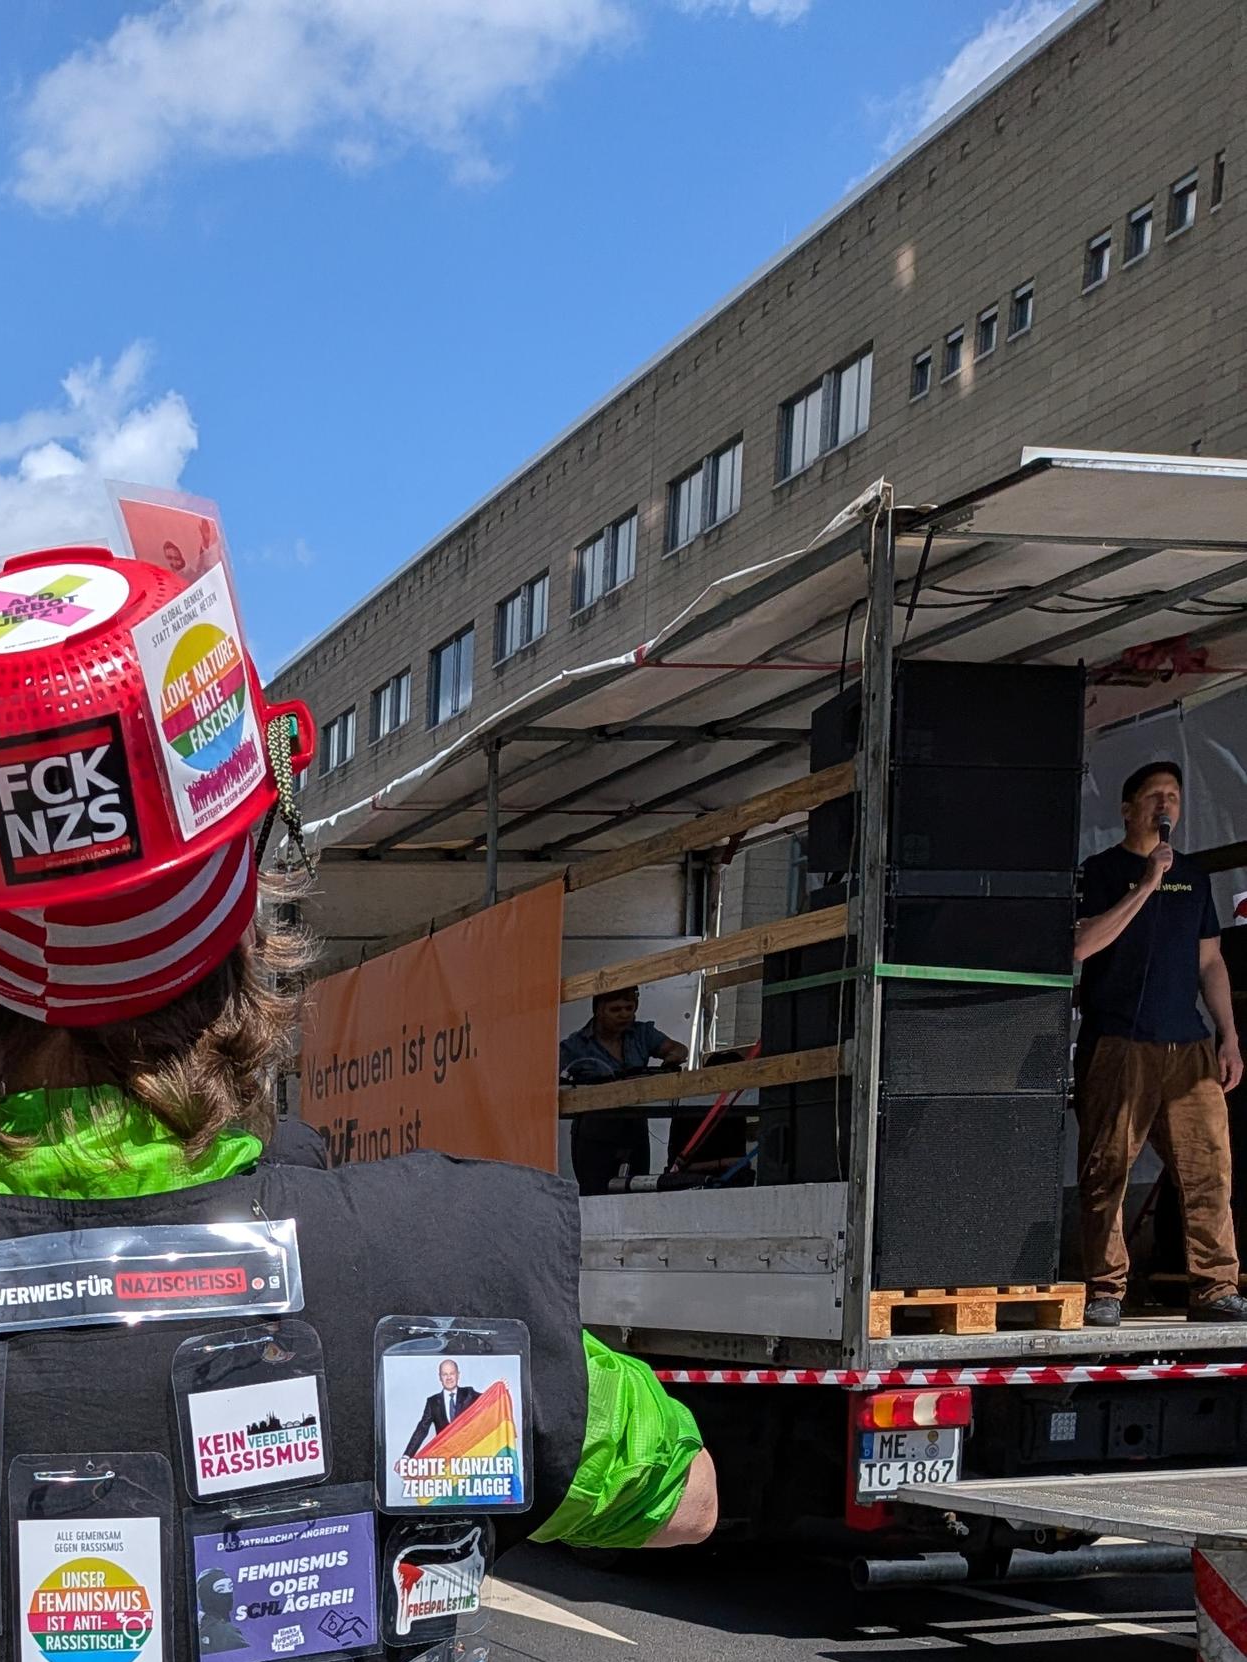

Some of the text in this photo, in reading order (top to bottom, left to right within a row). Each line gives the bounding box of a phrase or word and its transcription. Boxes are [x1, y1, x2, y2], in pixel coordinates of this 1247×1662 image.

[161, 635, 236, 713] LOVE NATURE
[192, 684, 224, 721] HATE
[189, 695, 239, 753] FASCISM
[4, 793, 127, 858] NZS
[307, 1011, 477, 1100] Vertrauen ist gut.
[399, 1106, 421, 1155] ist
[76, 1275, 113, 1297] FÜR
[121, 1272, 242, 1294] NAZISCHEISS!
[199, 1425, 318, 1457] KEIN VEEDEL FÜR
[880, 1434, 906, 1459] ME
[201, 1440, 320, 1479] RASSISMUS
[399, 1456, 514, 1477] ECHTE KANZLER
[865, 1460, 954, 1487] TC 1867
[402, 1477, 511, 1497] ZEIGEN FLAGGE
[55, 1543, 123, 1552] GEGEN RASSISMUS
[57, 1531, 121, 1540] ALLE GEMEINSAM
[217, 1524, 349, 1551] DAS PATRIARCHAT ANGREIFEN
[237, 1551, 349, 1582] FEMINISMUS
[62, 1572, 105, 1588] UNSER
[269, 1576, 319, 1596] ODER
[38, 1591, 141, 1612] FEMINISMUS
[47, 1615, 108, 1630] IST ANTI-
[46, 1635, 123, 1650] RASSISTISCH
